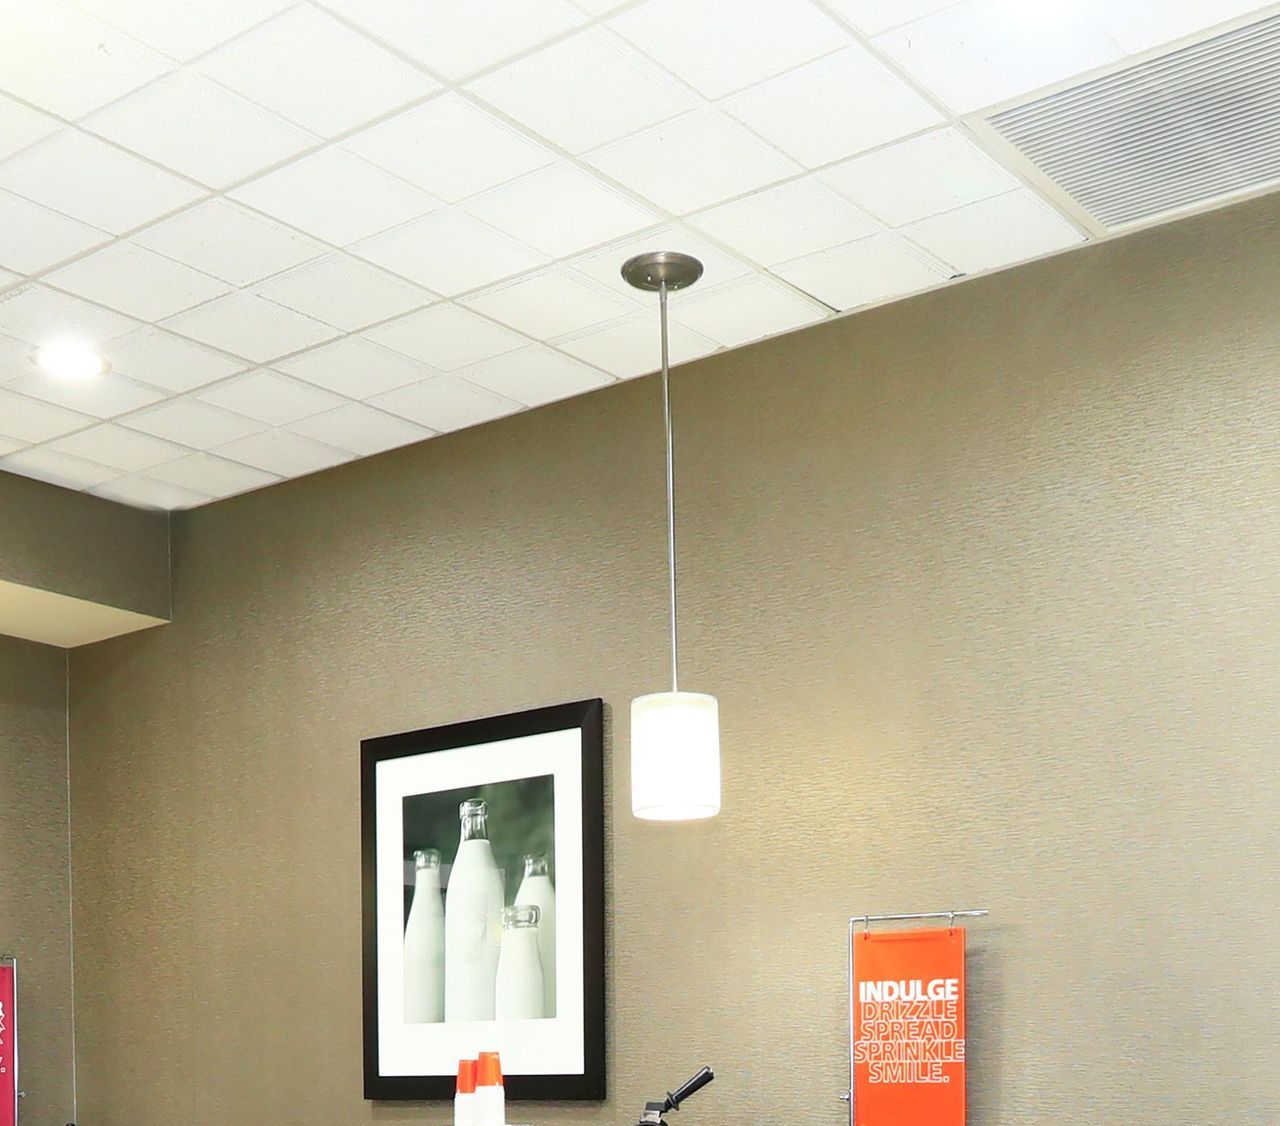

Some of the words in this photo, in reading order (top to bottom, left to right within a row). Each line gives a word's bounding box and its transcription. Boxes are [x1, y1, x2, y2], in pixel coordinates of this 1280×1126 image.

[859, 979, 959, 1001] INDULGE
[861, 1000, 957, 1021] DRIZZLE
[861, 1020, 958, 1041] SPREAD
[854, 1040, 965, 1063] SPRINKLE
[869, 1061, 950, 1083] SMILE.
